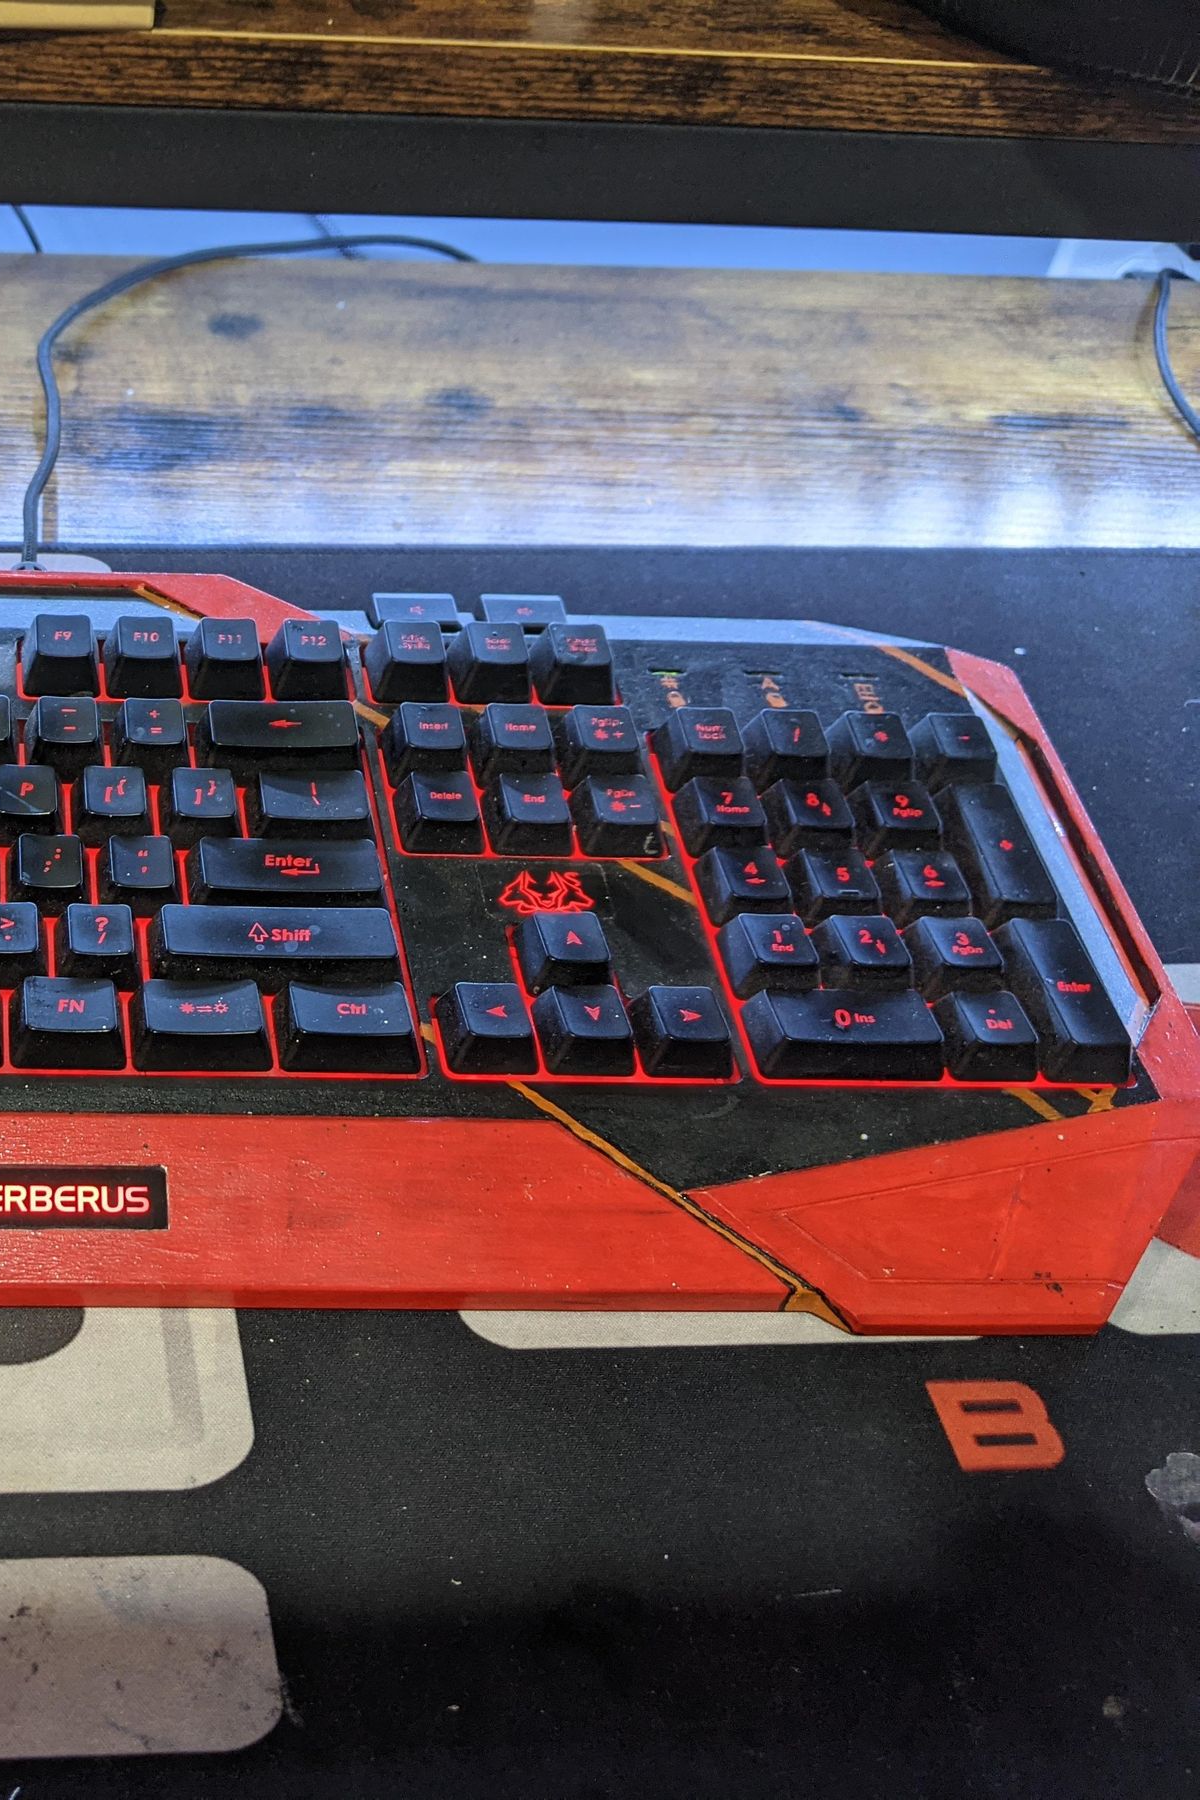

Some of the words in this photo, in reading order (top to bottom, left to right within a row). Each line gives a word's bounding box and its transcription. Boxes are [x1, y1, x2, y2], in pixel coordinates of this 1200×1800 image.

[54, 631, 72, 641] F9
[133, 631, 159, 642] F10
[218, 634, 242, 644] F11
[301, 635, 328, 646] F12
[19, 782, 34, 797] P
[523, 794, 545, 804] End
[720, 792, 733, 805] 7
[806, 792, 820, 807] 8
[895, 795, 909, 808] 9
[715, 804, 750, 814] Home
[264, 854, 313, 868] Enter
[743, 862, 758, 875] 4
[836, 867, 851, 882] 5
[923, 865, 939, 878] 6
[95, 916, 109, 932] ?
[271, 928, 312, 943] Shift
[772, 929, 784, 943] 1
[859, 929, 874, 944] 2
[956, 932, 970, 945] 3
[771, 943, 795, 953] End
[1057, 980, 1092, 993] Enter
[57, 999, 85, 1013] FN
[337, 1003, 367, 1015] Ctrl
[834, 1008, 851, 1027] 0
[854, 1013, 877, 1024] Ins
[986, 1018, 1014, 1030] Del
